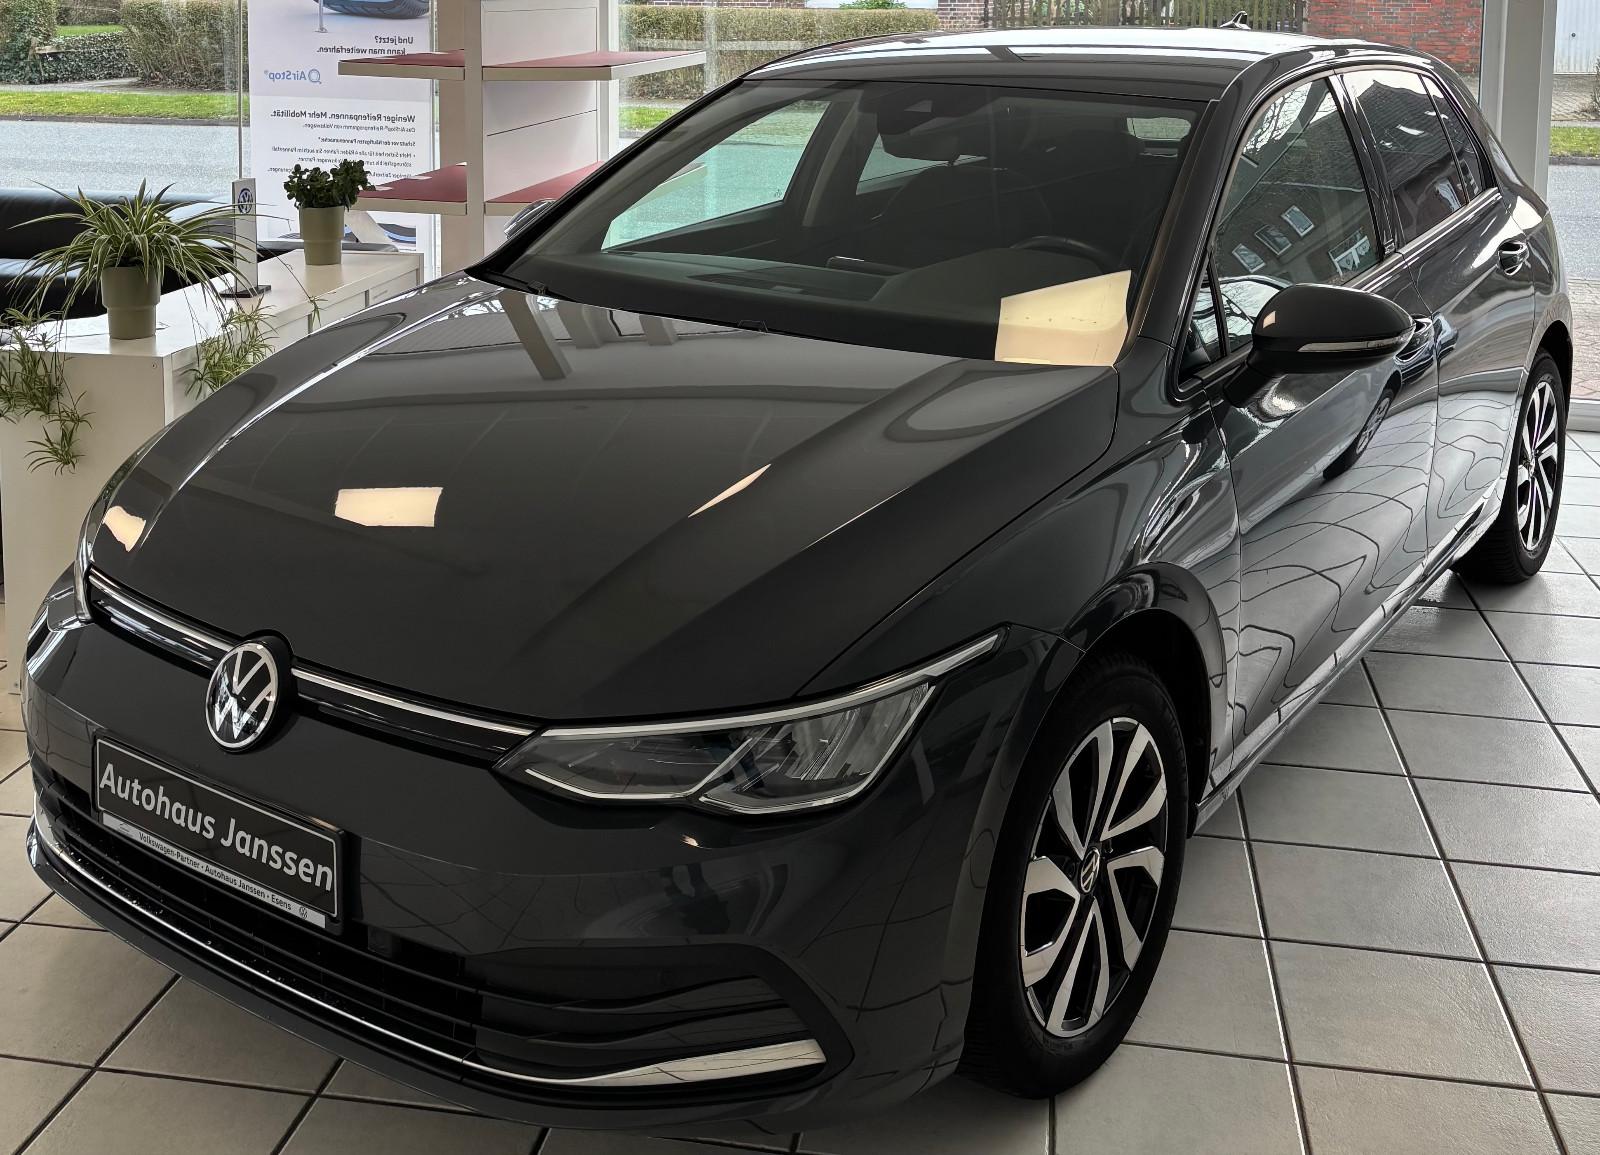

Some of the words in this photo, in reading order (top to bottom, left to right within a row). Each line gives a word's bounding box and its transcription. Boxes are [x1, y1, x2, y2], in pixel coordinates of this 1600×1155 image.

[100, 763, 215, 839] Autohaus
[220, 818, 333, 892] Janssen
[138, 832, 200, 869] Volkswagen-Partner
[205, 865, 238, 886] Autohaus
[238, 879, 266, 898] Janssen
[271, 894, 292, 911] Esens
